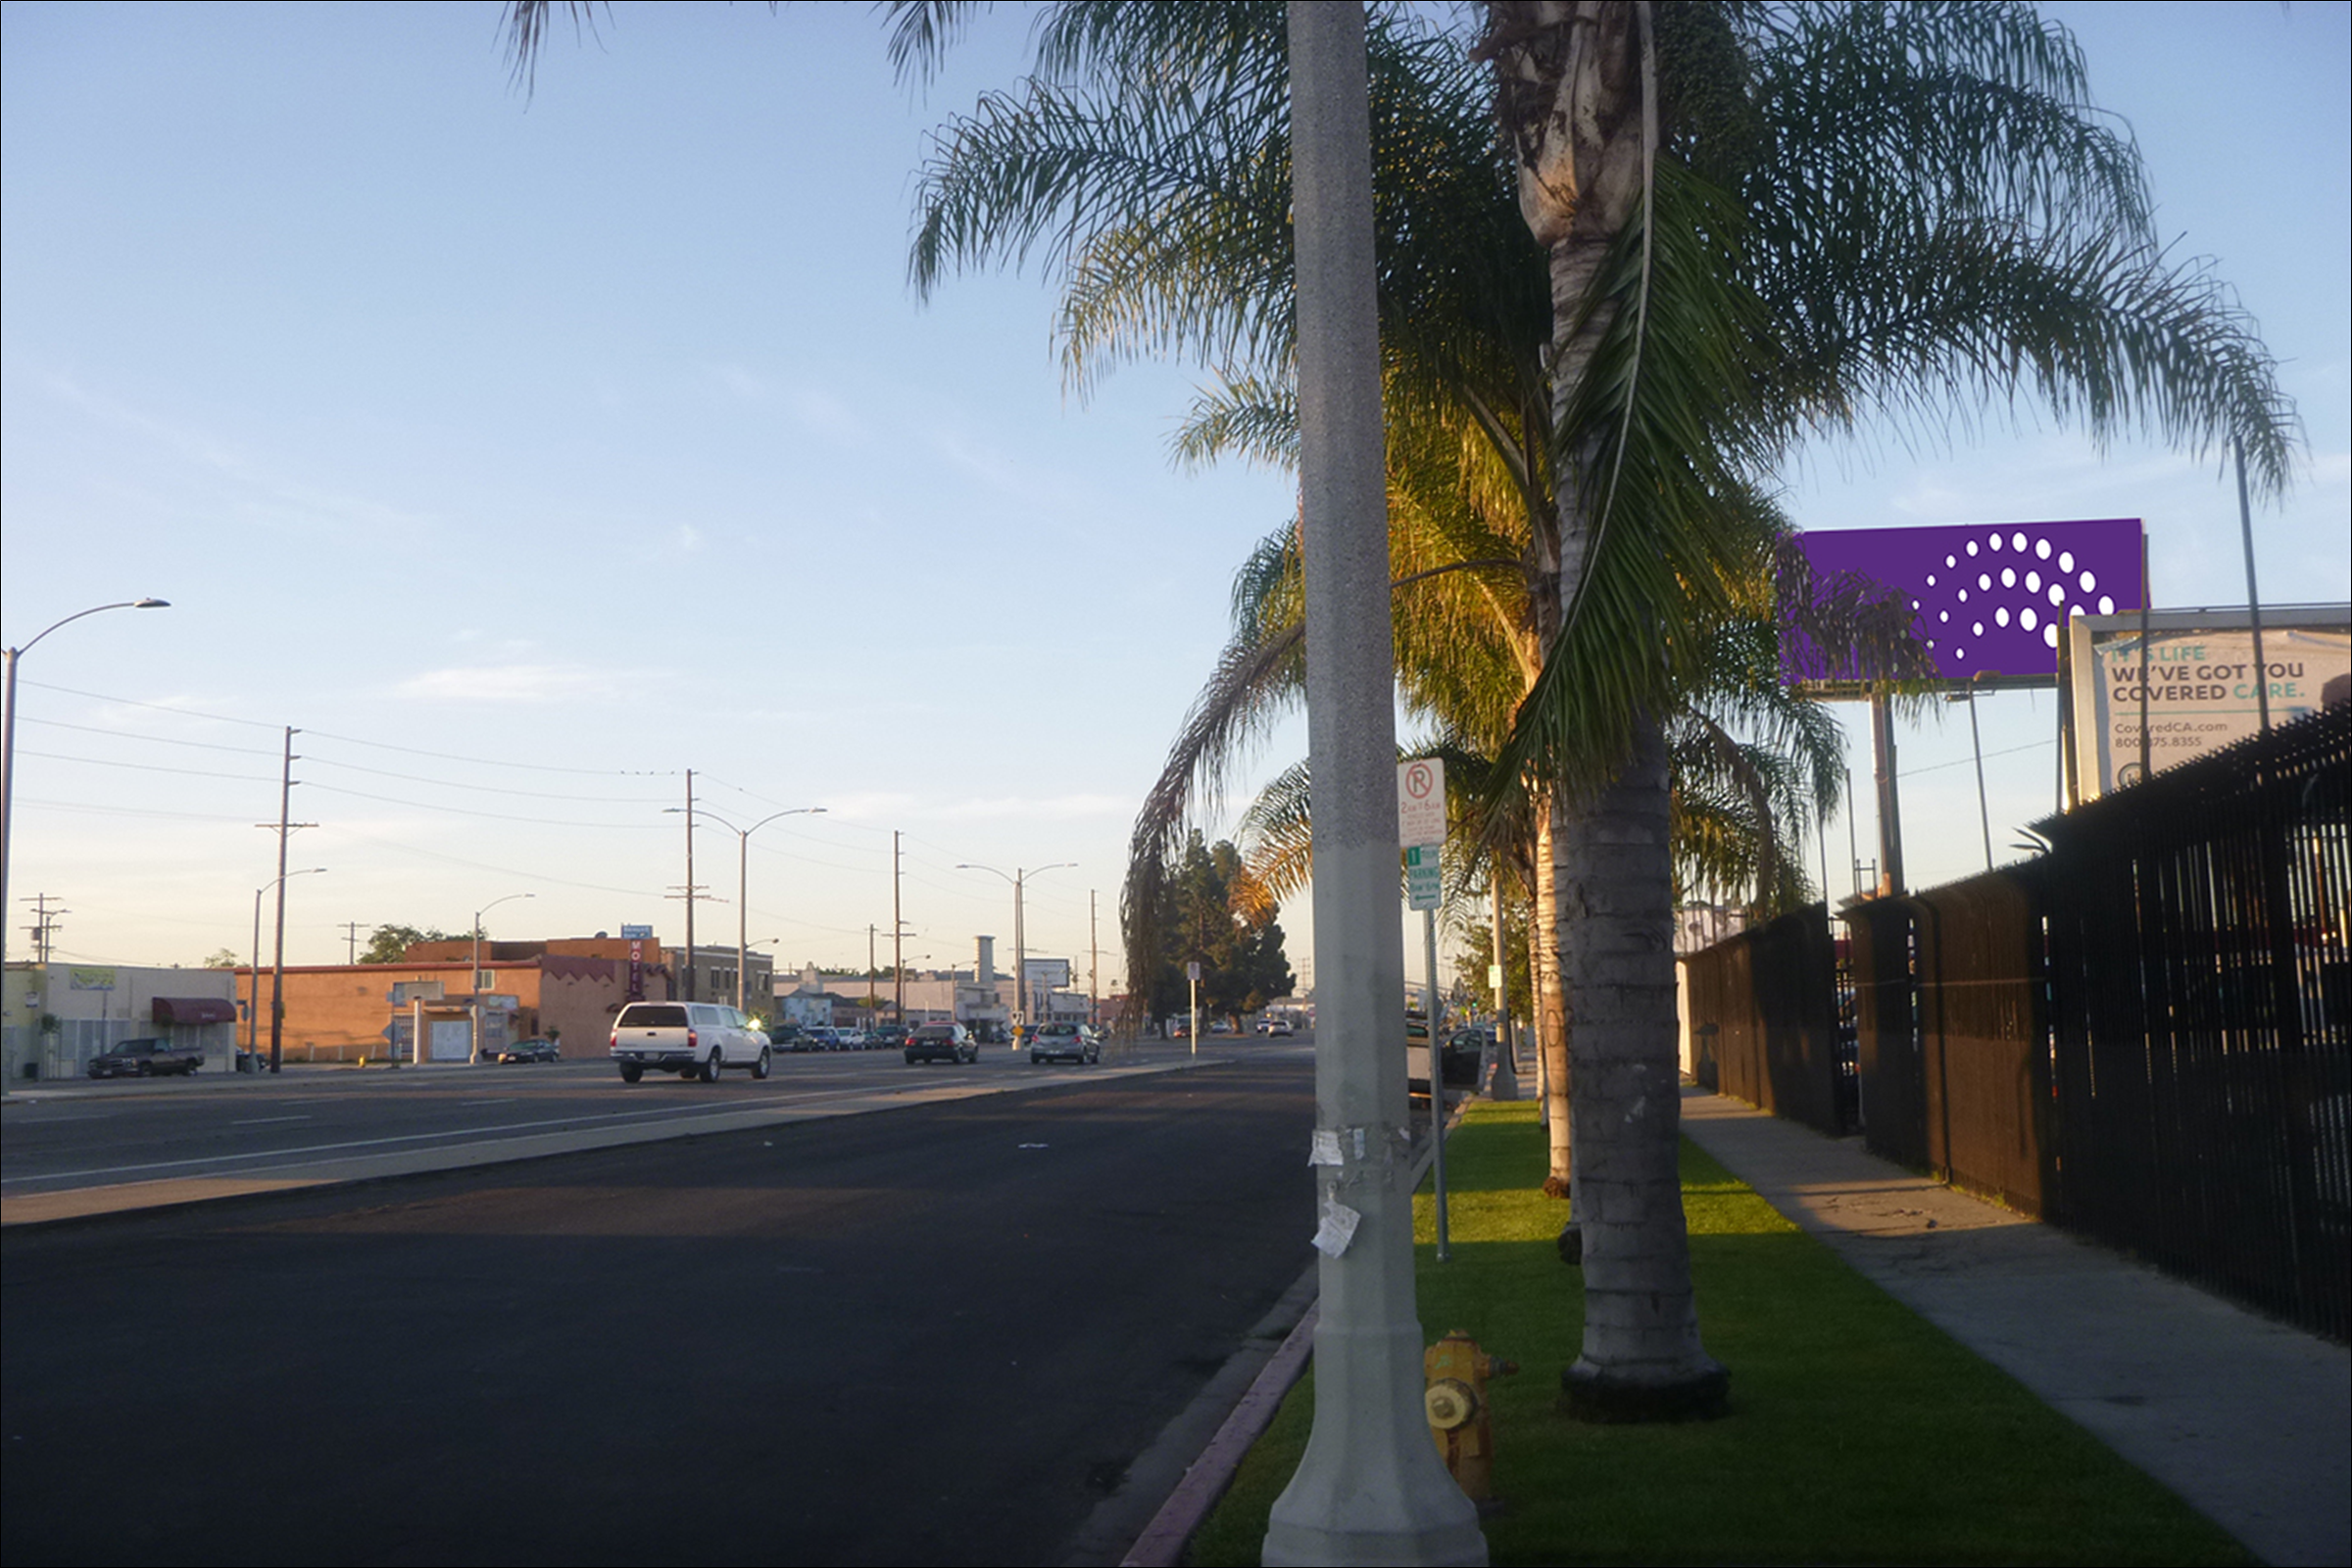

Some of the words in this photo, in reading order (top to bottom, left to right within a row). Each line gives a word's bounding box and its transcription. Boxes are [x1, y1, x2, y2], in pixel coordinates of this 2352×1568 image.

[2160, 646, 2205, 662] LIFE
[2196, 664, 2247, 681] GOT
[2113, 684, 2227, 702] COVERED
[2233, 682, 2305, 699] CARE.
[2115, 722, 2228, 733] CovredCA.com
[2115, 736, 2202, 748] 80075.8355
[1413, 769, 1425, 793] P
[631, 941, 641, 992] MOTEL
